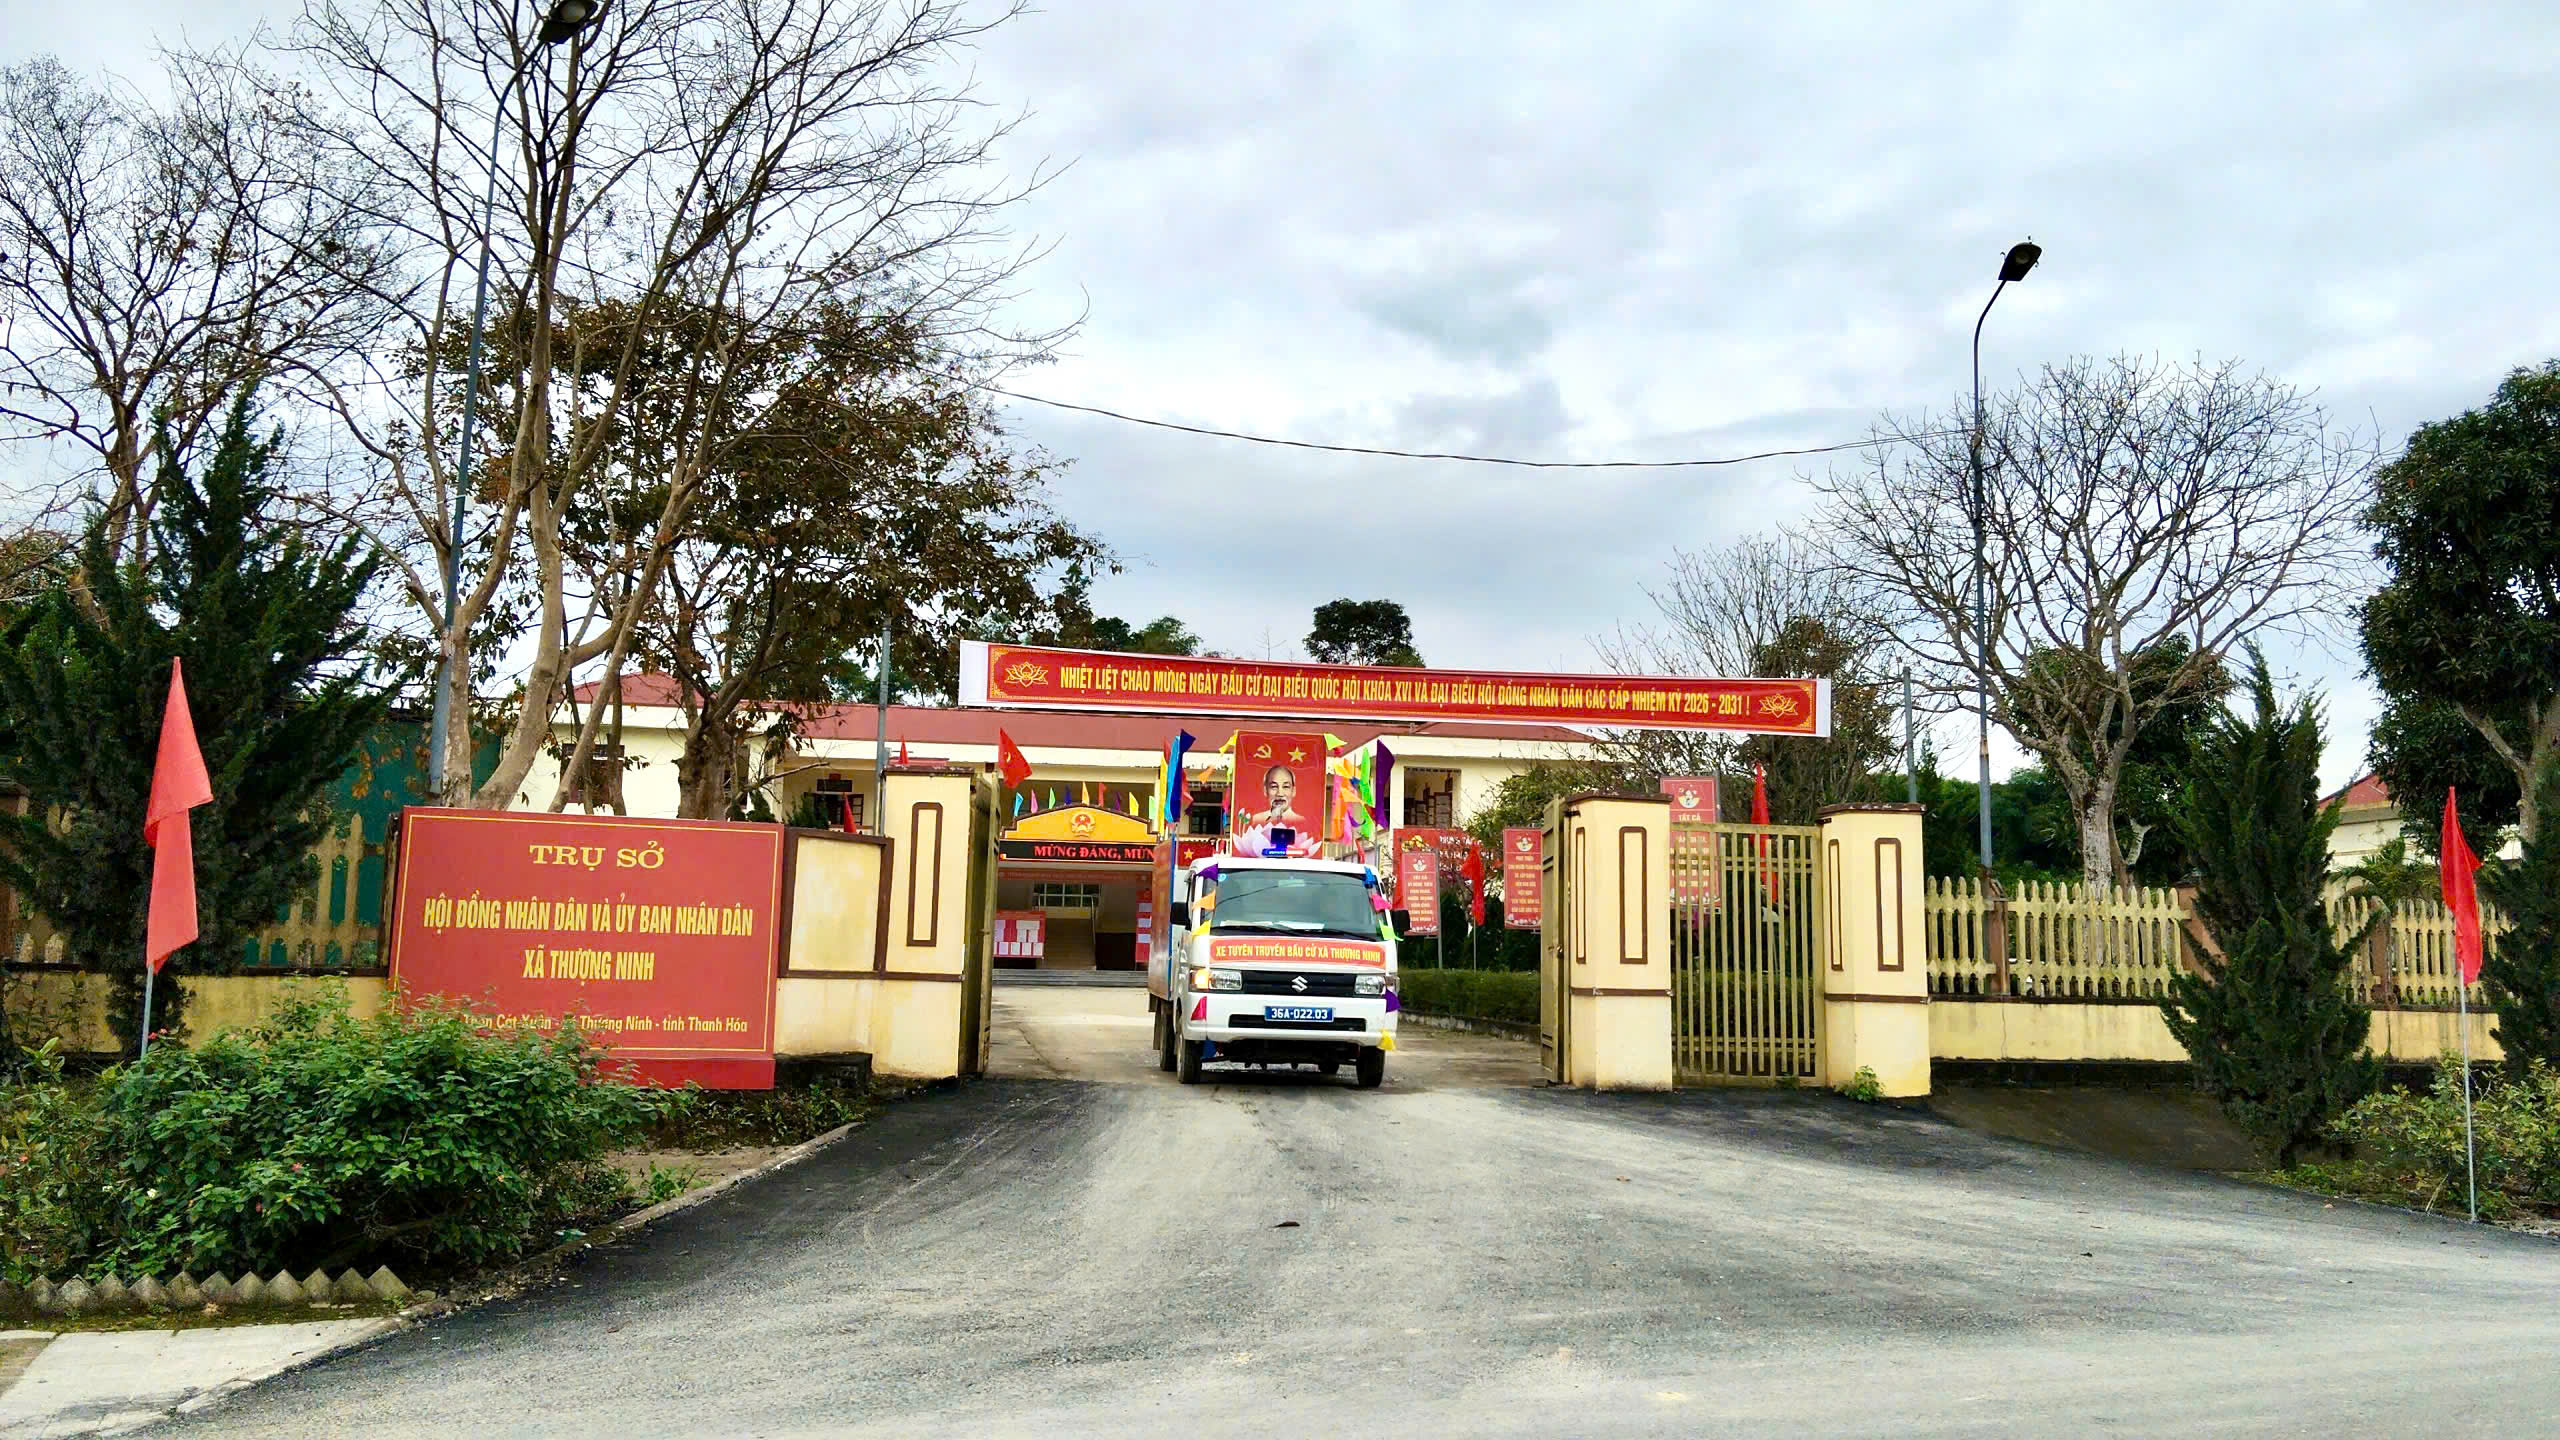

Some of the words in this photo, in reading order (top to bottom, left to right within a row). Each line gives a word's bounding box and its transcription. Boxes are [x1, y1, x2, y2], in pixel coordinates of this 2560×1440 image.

[1060, 662, 1093, 694] NHIỆT
[1095, 664, 1118, 695] LIỆT
[1120, 665, 1150, 692] CHÀO
[1153, 666, 1186, 693] MỪNG
[1189, 668, 1219, 695] NGÀY
[1246, 666, 1262, 696] CỬ
[1263, 675, 1281, 702] ĐẠI
[1284, 669, 1308, 698] BIỂU
[1312, 671, 1339, 700] QUỐC
[1343, 675, 1361, 704] HỘI
[1364, 675, 1391, 702] KHÓA
[1395, 681, 1412, 702] XVI
[1415, 677, 1428, 703] VÀ
[1431, 682, 1449, 708] ĐẠI
[1451, 676, 1475, 705] BIỂU
[1478, 680, 1496, 709] HỘI
[1498, 679, 1527, 706] ĐỒNG
[1530, 682, 1558, 708] NHÂN
[1561, 683, 1583, 708] DÂN
[1585, 684, 1606, 709] CÁC
[1609, 683, 1629, 710] CẤP
[1632, 687, 1666, 716] NHIỆM
[1684, 693, 1709, 714] 2026
[1718, 695, 1743, 715] 2031
[529, 844, 606, 872] TRỤ
[616, 840, 665, 869] SỞ
[1034, 843, 1076, 857] MỪNG
[1124, 846, 1154, 859] MỪN
[423, 892, 452, 935] HỘI
[455, 889, 501, 929] ĐỒNG
[505, 895, 551, 930] NHÂN
[553, 896, 588, 932] DÂN
[592, 897, 611, 932] VÀ
[615, 892, 636, 933] ỦY
[639, 904, 672, 934] BAN
[675, 901, 718, 936] NHÂN
[721, 902, 753, 936] DÂN
[522, 944, 545, 979] XÃ
[550, 947, 612, 986] THƯỢNG
[615, 951, 655, 981] NINH
[1215, 945, 1226, 957] XE
[1228, 944, 1253, 957] TUYÊN
[1305, 943, 1316, 958] CỬ
[1331, 947, 1361, 962] THƯỢNG
[1362, 951, 1381, 963] NINH
[625, 1015, 652, 1032] Ninh
[662, 1014, 685, 1032] tỉnh
[688, 1016, 722, 1033] Thanh
[725, 1016, 748, 1033] Hóa
